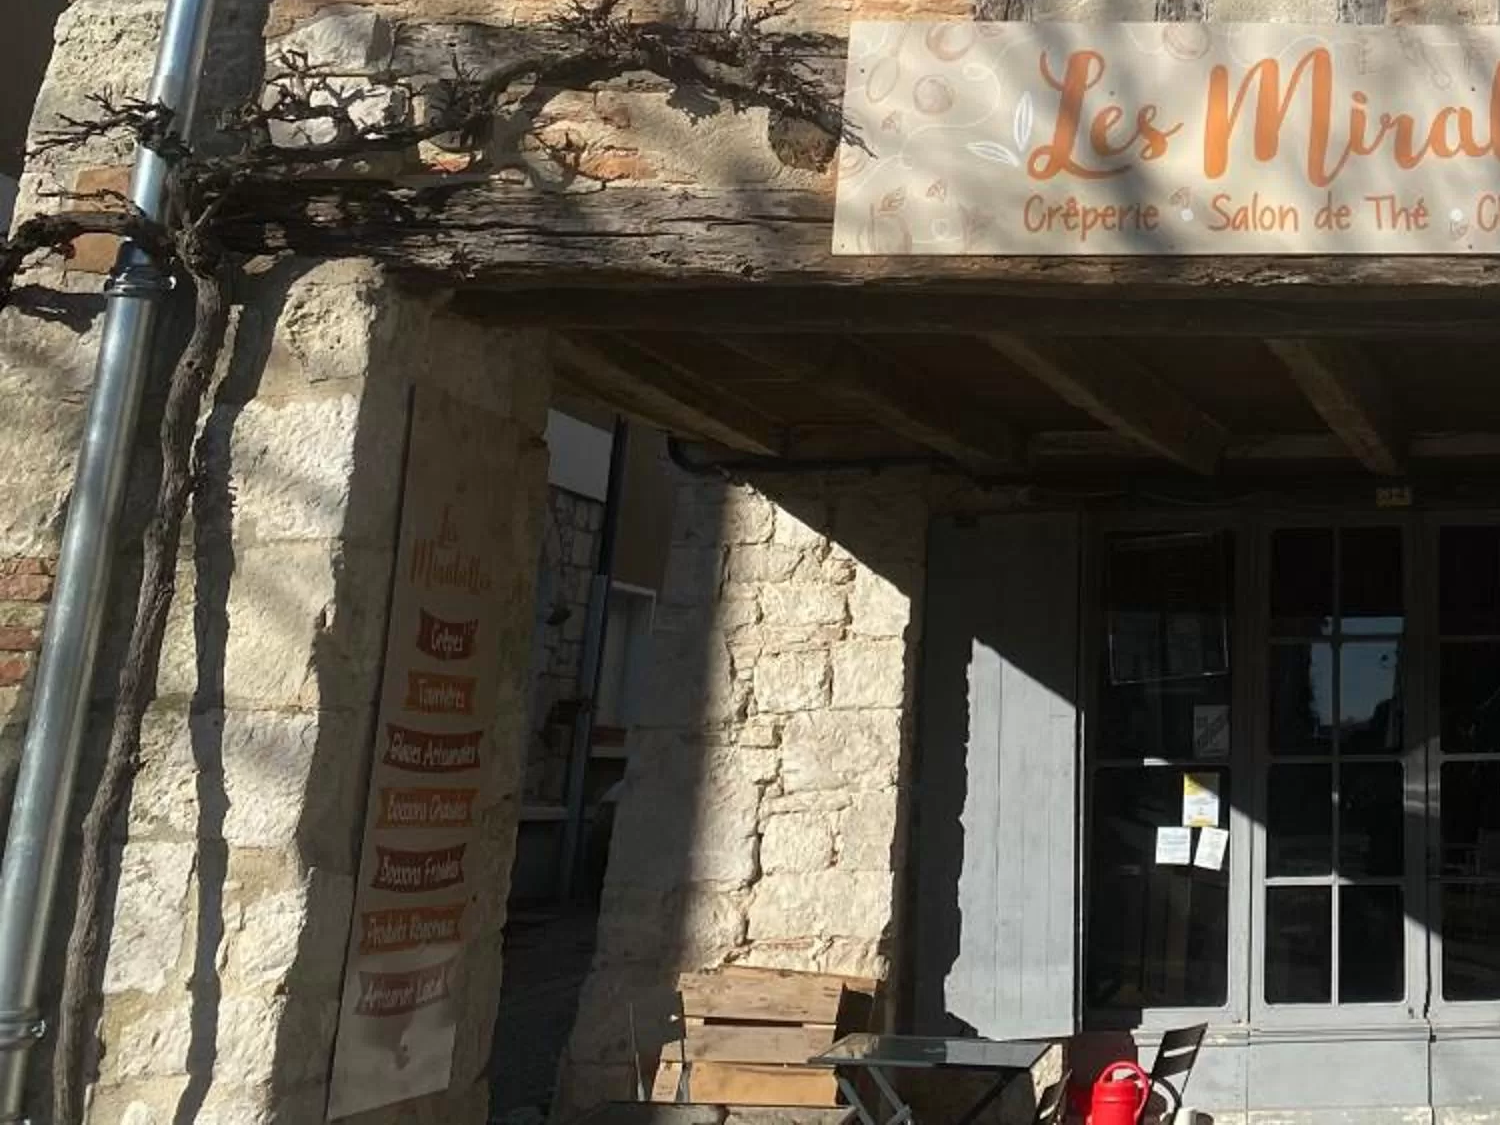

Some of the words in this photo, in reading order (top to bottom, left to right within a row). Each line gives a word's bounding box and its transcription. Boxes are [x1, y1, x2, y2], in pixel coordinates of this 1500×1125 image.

[1026, 49, 1183, 181] Les
[1023, 193, 1160, 242] Crêperie
[1207, 192, 1299, 232] Salon
[1314, 191, 1352, 231] de
[1365, 191, 1430, 231] Thé
